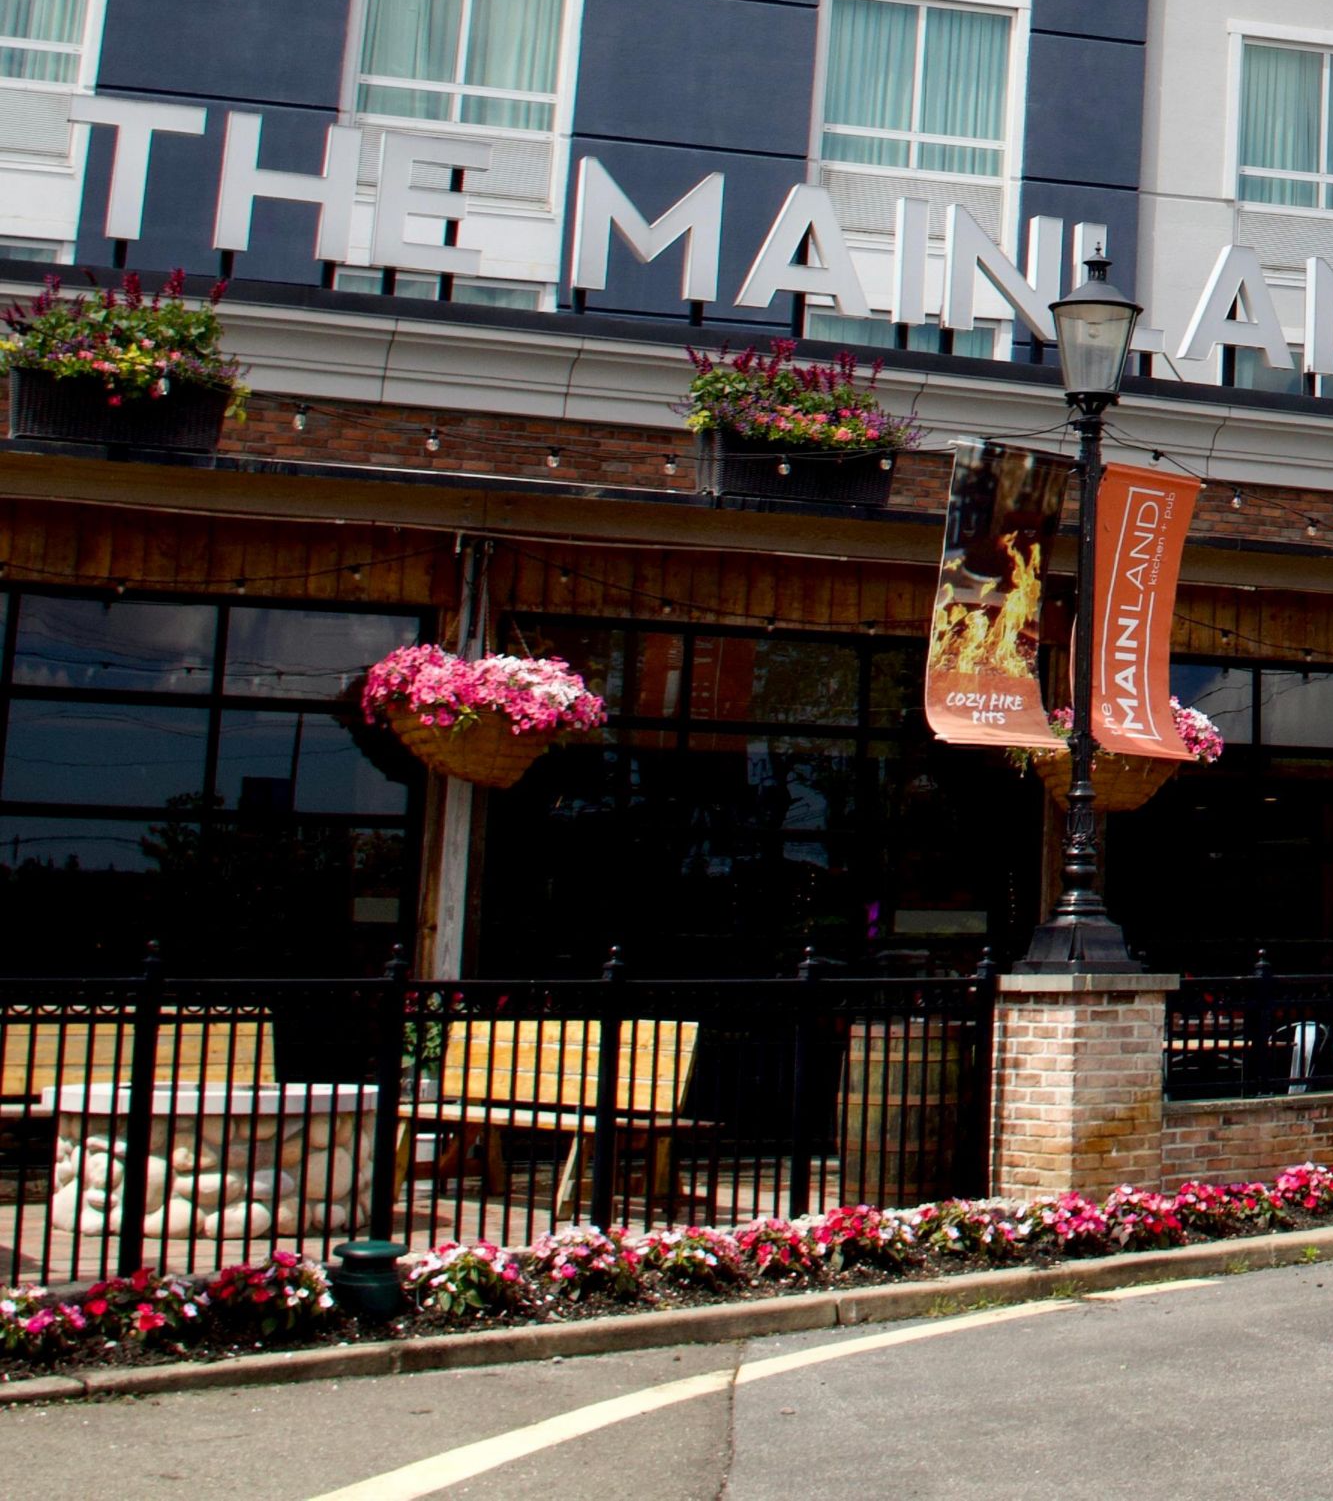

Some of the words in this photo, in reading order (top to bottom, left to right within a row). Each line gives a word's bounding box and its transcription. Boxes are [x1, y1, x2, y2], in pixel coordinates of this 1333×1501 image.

[68, 93, 493, 277] THE
[1147, 536, 1166, 586] kitchen
[1163, 491, 1177, 520] pub
[1114, 501, 1159, 731] MAINLAND
[945, 691, 987, 710] COZY
[989, 692, 1024, 711] FIRE
[972, 710, 1006, 725] PITS
[1101, 703, 1123, 735] the
